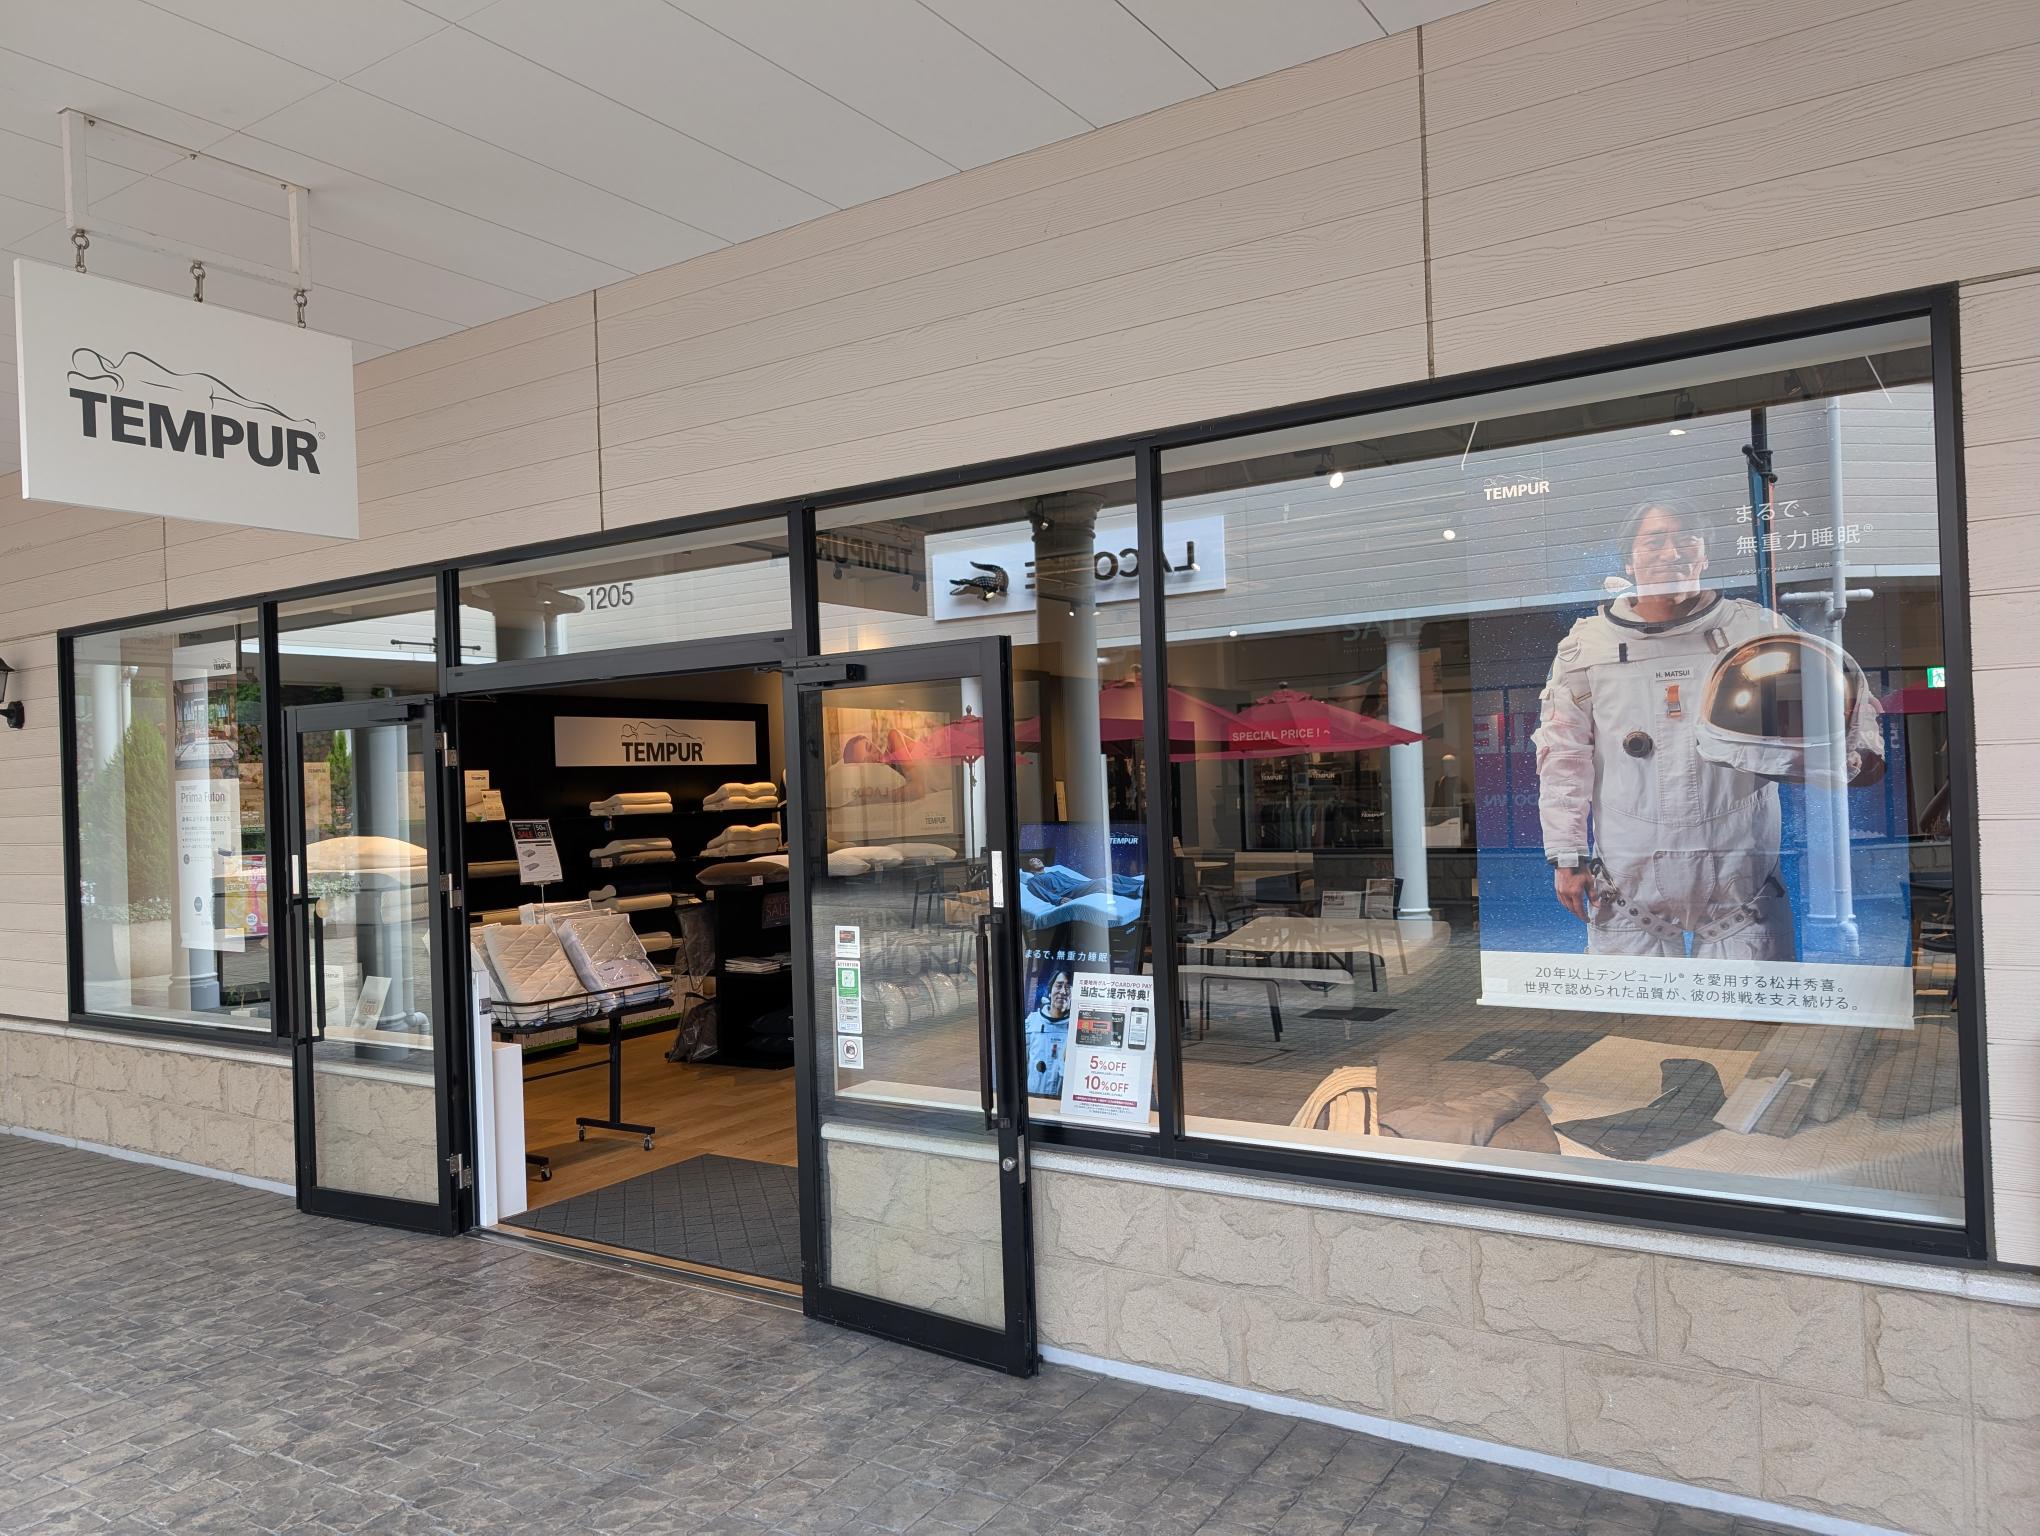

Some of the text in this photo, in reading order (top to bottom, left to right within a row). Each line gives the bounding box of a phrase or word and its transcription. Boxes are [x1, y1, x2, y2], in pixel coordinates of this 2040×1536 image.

[1483, 480, 1550, 501] TEMPUR
[1735, 500, 1810, 524] まるで、
[586, 582, 635, 611] 1205
[1664, 669, 1690, 678] MATSUI
[1232, 730, 1278, 742] SPECIAL
[1280, 728, 1314, 740] PRICE
[622, 741, 704, 762] TEMPUR
